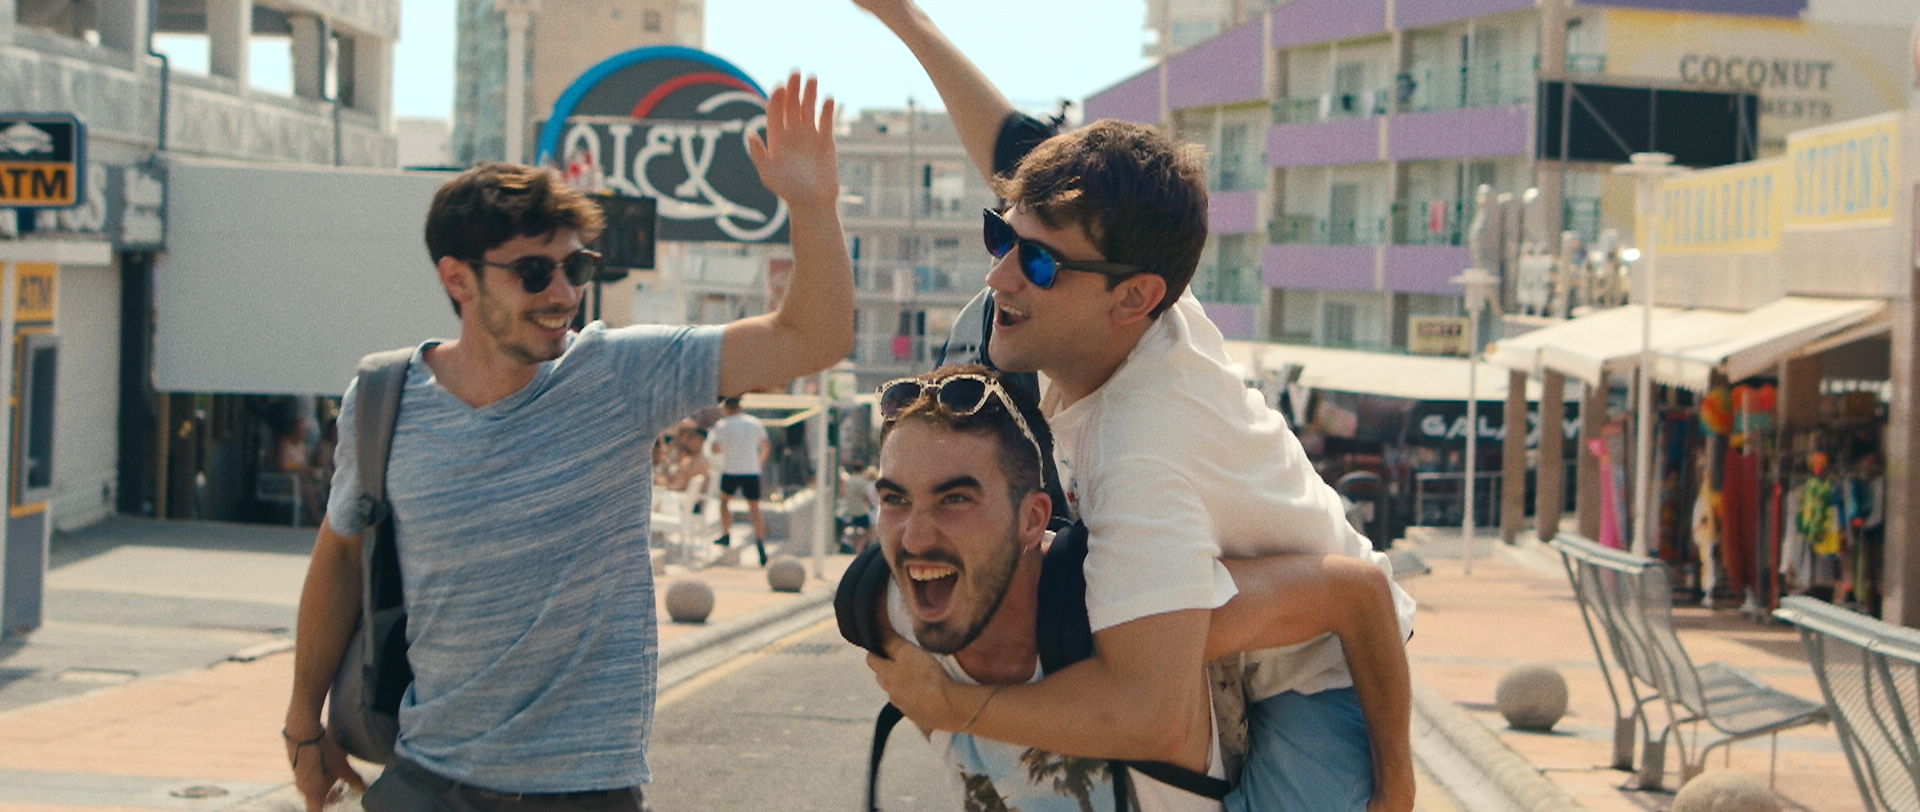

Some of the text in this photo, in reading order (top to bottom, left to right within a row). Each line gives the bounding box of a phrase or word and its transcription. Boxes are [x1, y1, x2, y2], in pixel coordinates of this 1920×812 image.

[1679, 54, 1833, 90] COCONUT
[0, 168, 68, 199] TM
[18, 275, 53, 311] ATM
